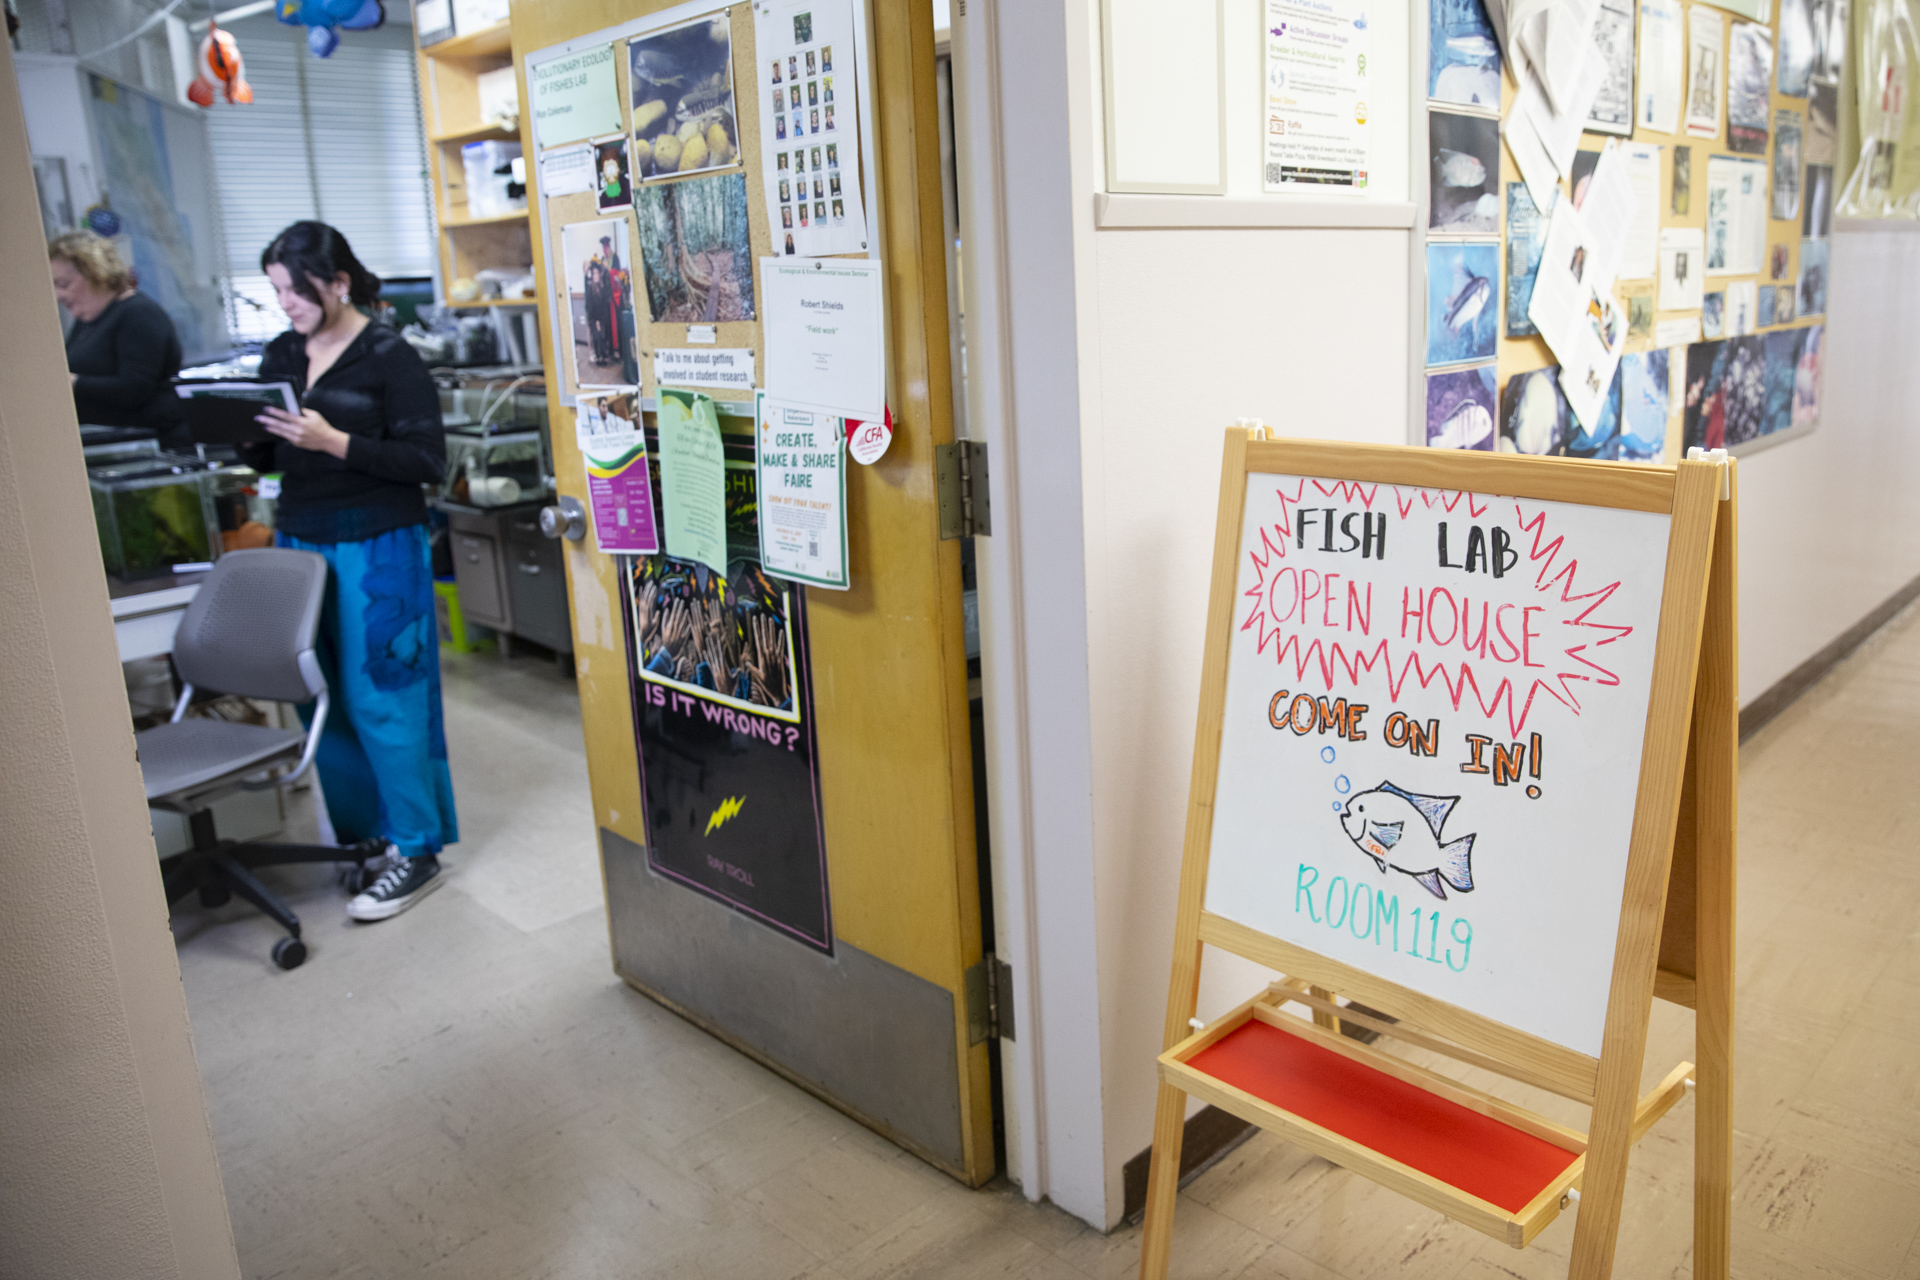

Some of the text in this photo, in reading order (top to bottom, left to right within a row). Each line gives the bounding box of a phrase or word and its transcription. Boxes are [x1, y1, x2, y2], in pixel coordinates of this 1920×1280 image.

[582, 49, 613, 68] ECOLOGY
[549, 76, 574, 92] FISHES
[575, 73, 588, 87] LAB
[800, 299, 844, 310] Robert Shields
[662, 352, 734, 367] Talk to me about getting
[663, 368, 748, 382] involved in student research
[776, 433, 818, 449] CREATE,
[864, 426, 883, 444] CFA
[763, 453, 836, 468] MAKE & SHARE
[784, 474, 812, 488] FAIRE
[1297, 508, 1518, 578] FISH LAB
[1269, 567, 1546, 668] OPEN HOUSE
[644, 682, 800, 752] IS IT WRONG?
[1269, 690, 1542, 800] COME ON IN!
